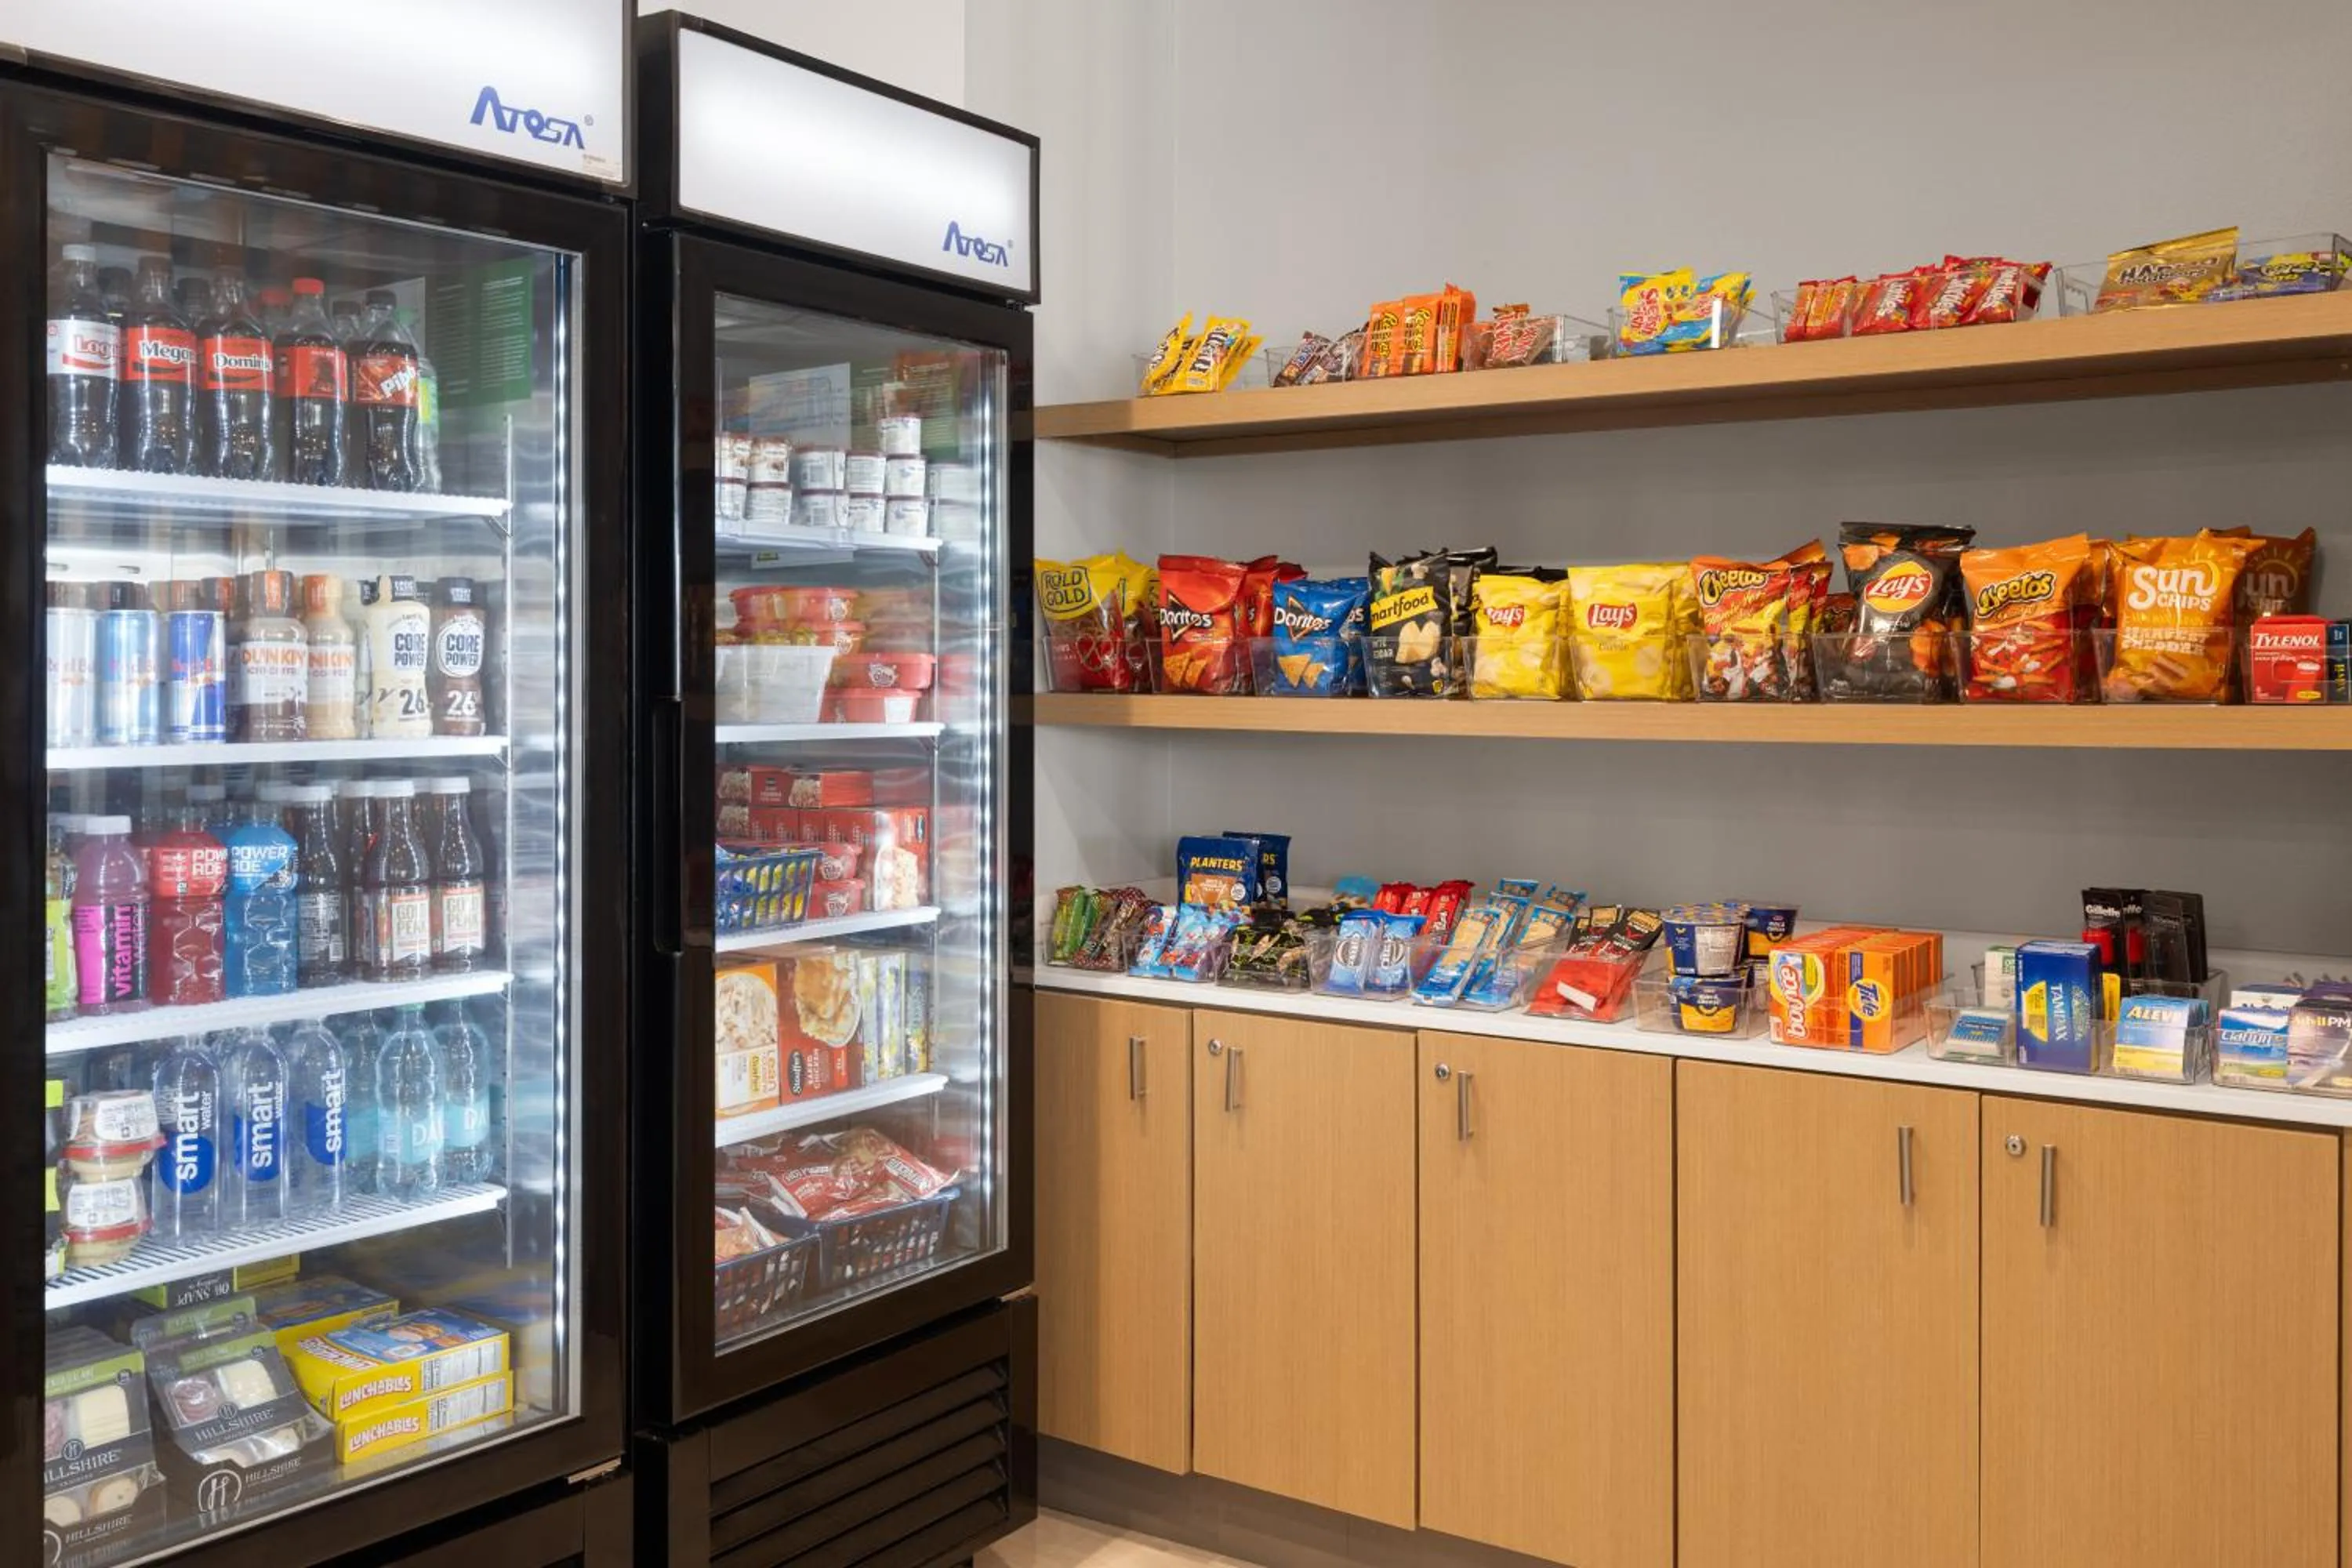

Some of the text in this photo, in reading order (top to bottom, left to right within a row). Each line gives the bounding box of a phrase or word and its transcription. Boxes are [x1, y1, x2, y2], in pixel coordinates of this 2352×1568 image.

[1045, 570, 1083, 590] ROLD
[2128, 565, 2218, 611] Sun
[1046, 588, 1086, 606] GOLD
[2157, 593, 2212, 612] CHIPS
[1160, 608, 1213, 628] Doritos
[1273, 607, 1333, 631] Doritos
[394, 633, 426, 652] CORE
[445, 633, 481, 653] CORE
[2255, 633, 2320, 648] TYLENOL
[394, 652, 426, 666] POWER
[445, 653, 479, 667] POWER
[399, 688, 426, 716] 26
[447, 690, 477, 717] 26
[1190, 856, 1243, 872] PLANTERS
[114, 904, 132, 996] vitamin
[1780, 965, 1807, 1039] bounce
[1857, 982, 1878, 1017] Tide
[2051, 983, 2068, 1041] TAMPAX
[2327, 1017, 2352, 1028] PM
[201, 1091, 213, 1131] water
[322, 1068, 343, 1153] smart
[175, 1091, 199, 1181] smart
[249, 1081, 273, 1168] smart
[339, 1377, 413, 1410] LUNCHABLES
[195, 1409, 274, 1442] HILLSHIRE
[350, 1417, 421, 1452] LUNCHABLES
[245, 1458, 302, 1483] HILLSHIRE
[65, 1515, 134, 1544] HILLSHIRE
